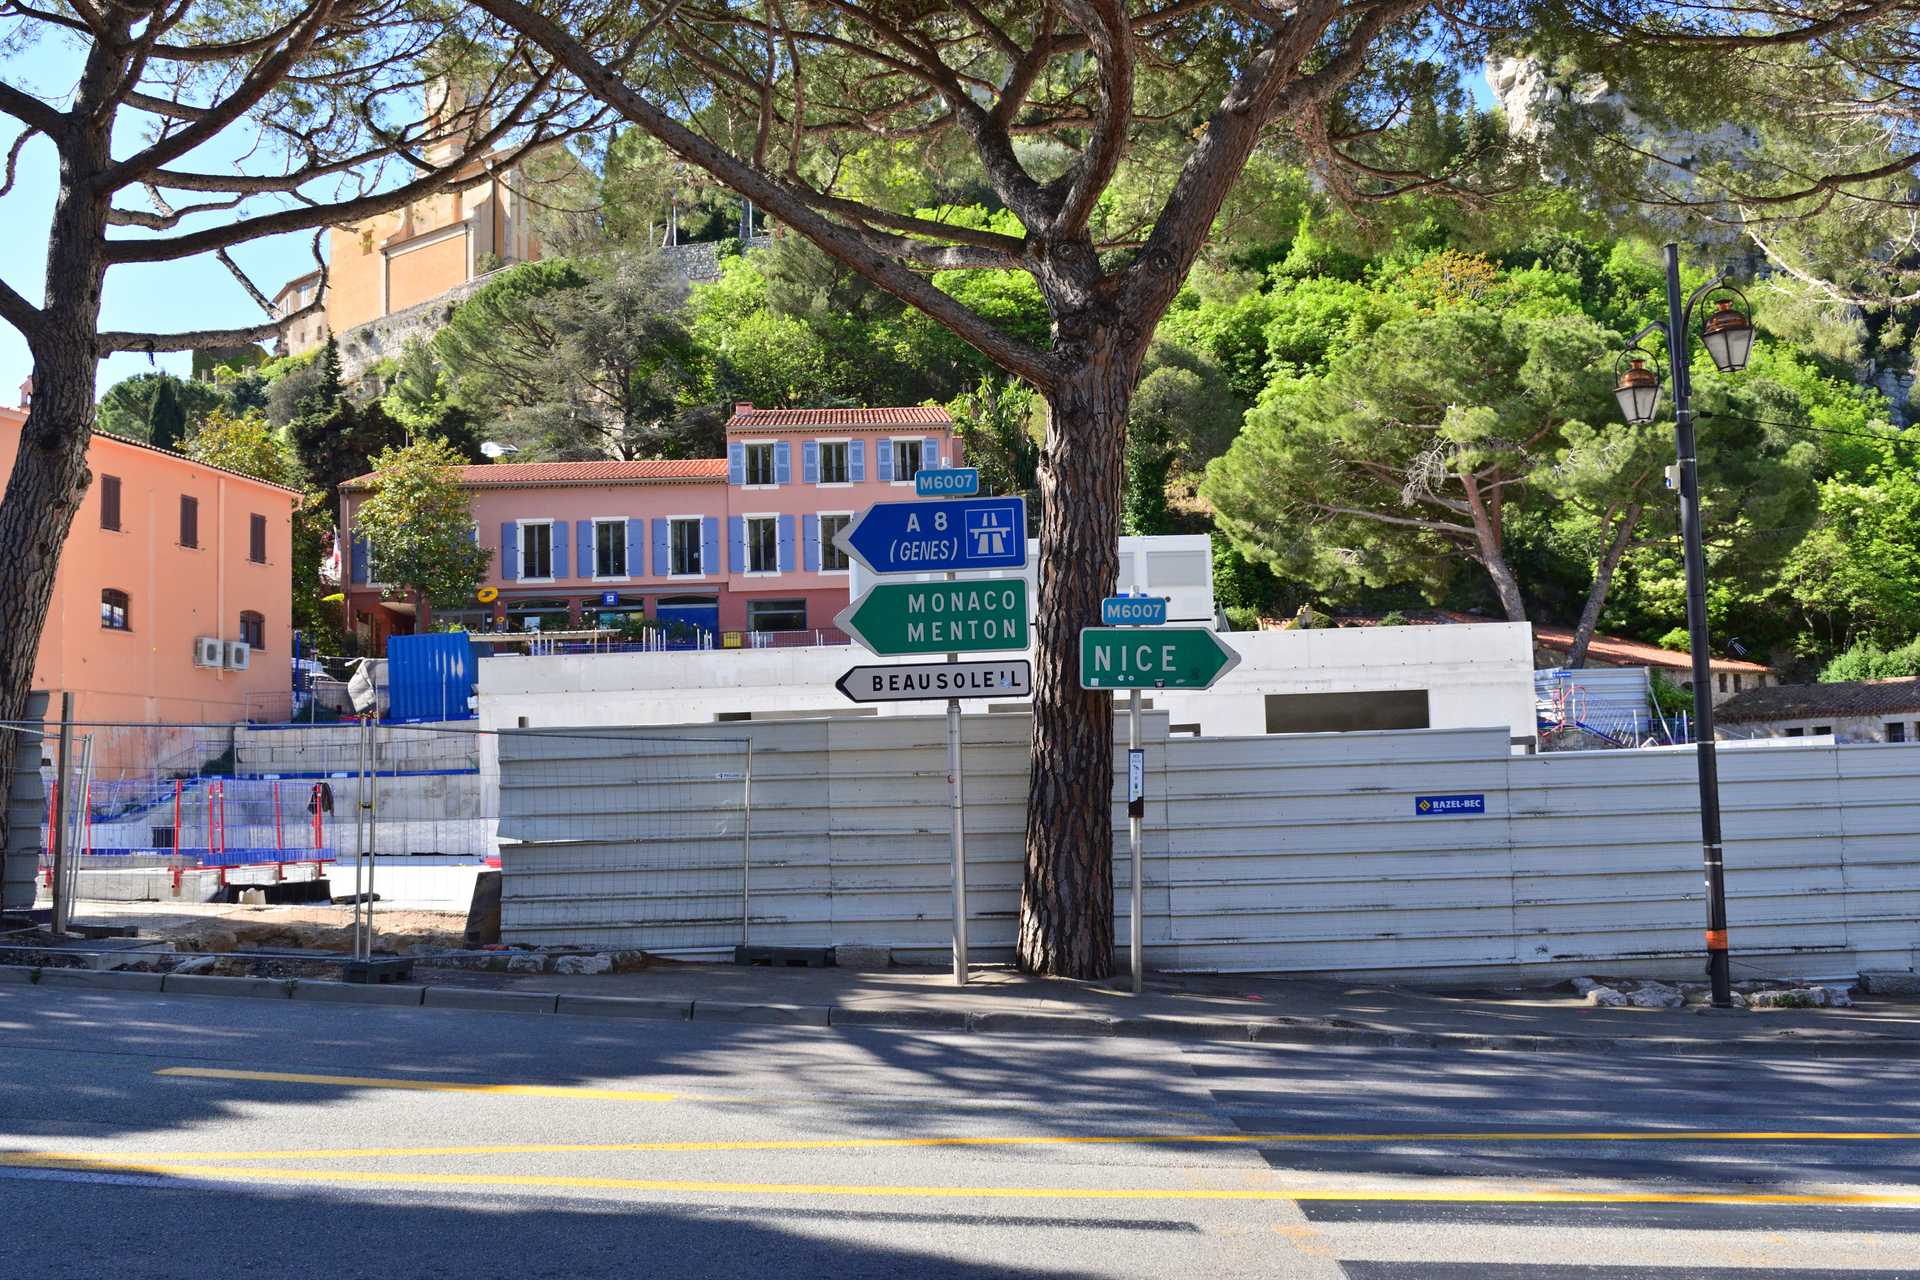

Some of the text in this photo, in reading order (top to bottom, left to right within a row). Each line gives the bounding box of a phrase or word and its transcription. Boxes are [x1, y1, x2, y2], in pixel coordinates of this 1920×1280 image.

[920, 474, 973, 490] M6007
[906, 511, 948, 533] A 8
[889, 537, 958, 563] (GENES)
[908, 590, 1016, 614] MONACO
[1107, 604, 1162, 618] M6007
[907, 618, 1016, 643] MENTON
[1094, 645, 1176, 672] NICE
[872, 670, 1021, 692] BEAUSOLEIL
[1432, 799, 1481, 809] RAZEL-BEC
